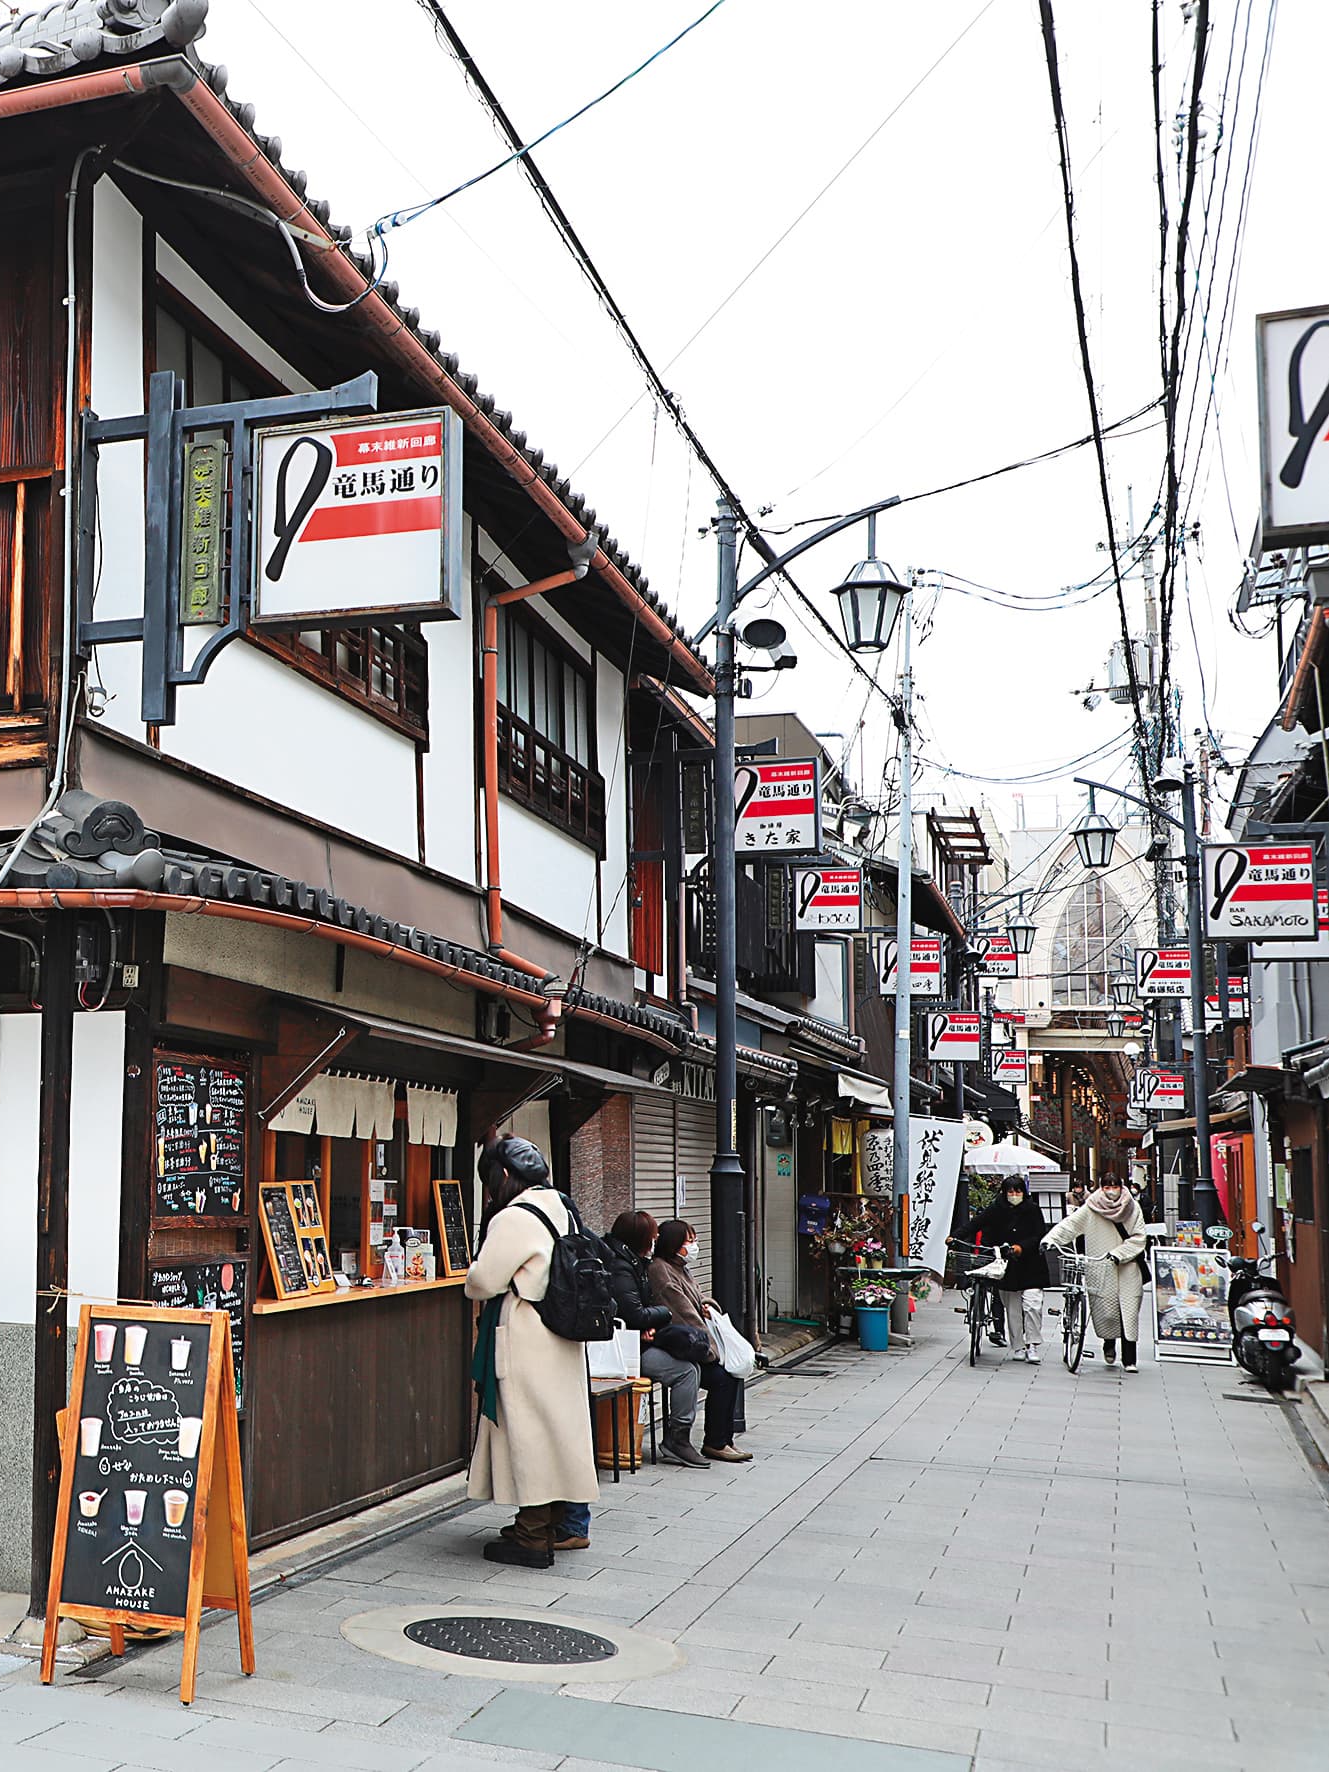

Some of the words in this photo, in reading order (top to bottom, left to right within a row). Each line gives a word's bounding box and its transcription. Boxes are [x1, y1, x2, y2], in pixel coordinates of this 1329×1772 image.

[357, 435, 437, 454] 幕末維新回廊
[332, 464, 439, 499] 竜馬通り
[759, 783, 812, 798] 竜馬通り
[745, 828, 801, 847] きた家
[1249, 867, 1311, 882] 竜馬通り
[1229, 913, 1309, 927] SAKAMOTO
[910, 952, 939, 961] 馬通り
[909, 1128, 944, 1260] 伏見粕汁銀座
[112, 1459, 132, 1472] ぜひ
[106, 1586, 156, 1599] AMAZAKE
[115, 1597, 151, 1610] HOUSE
